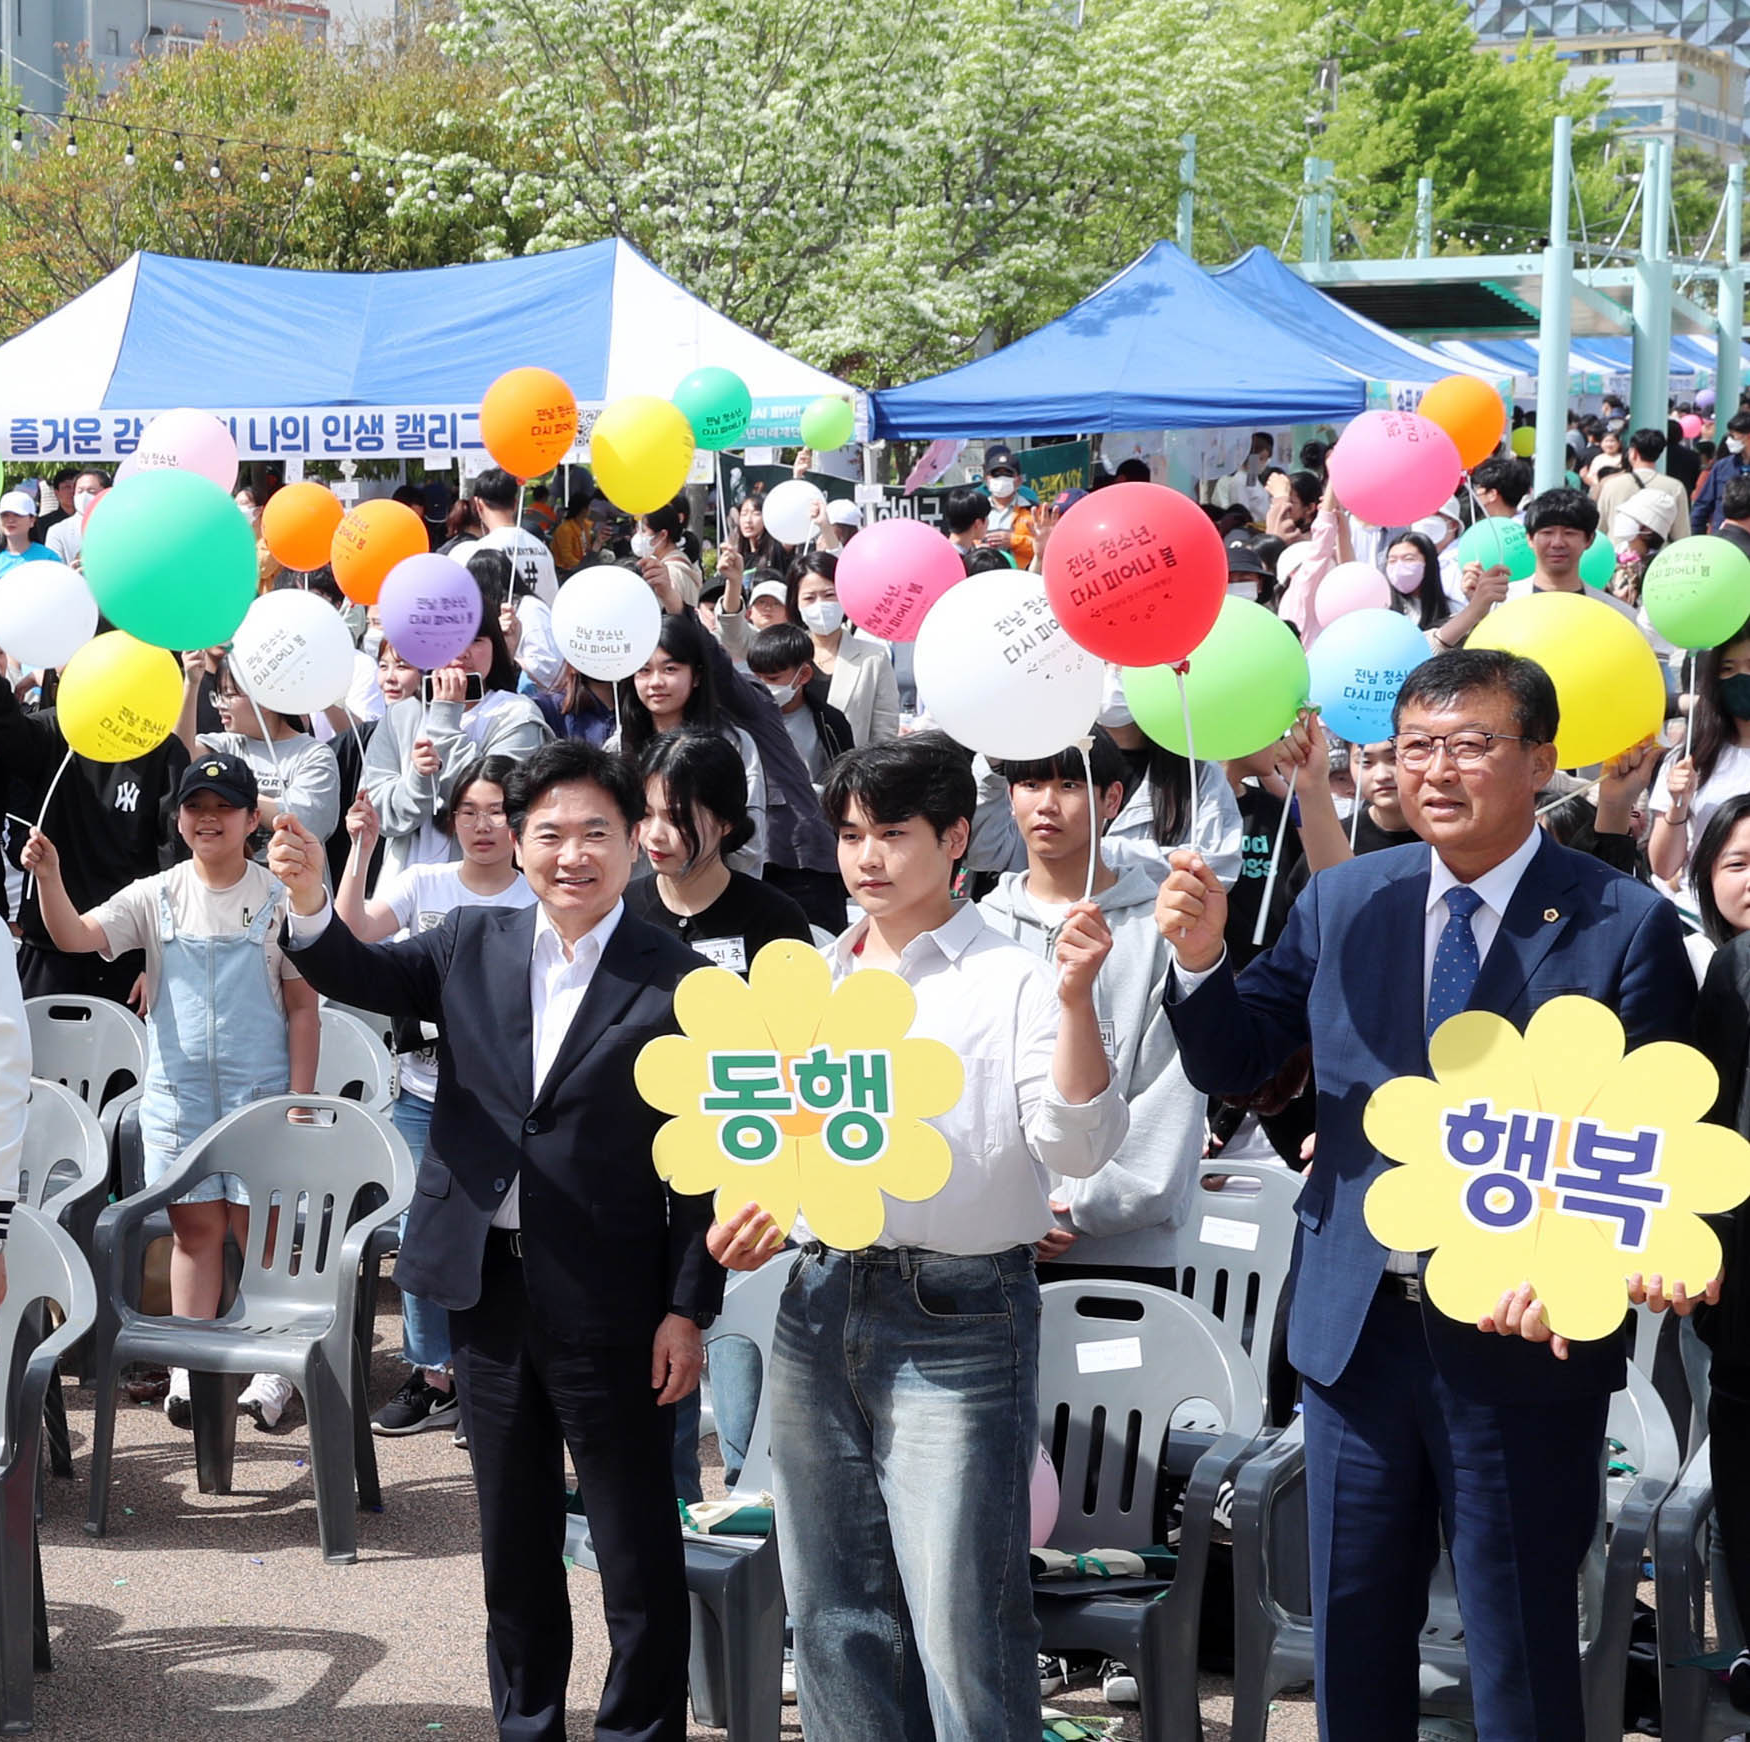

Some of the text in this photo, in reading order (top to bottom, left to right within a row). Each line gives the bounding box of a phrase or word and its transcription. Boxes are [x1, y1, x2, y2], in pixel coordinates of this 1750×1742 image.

[10, 417, 103, 455] 즐거운
[249, 416, 311, 452] 나의
[322, 414, 384, 451] 인생
[1066, 525, 1158, 579] 전남 청소년,
[1070, 581, 1102, 607] 다시
[1101, 553, 1157, 592] 피어나
[1159, 546, 1178, 569] 봄
[993, 609, 1027, 637] 전남
[1002, 634, 1038, 665] 다시
[1343, 686, 1370, 702] 다시
[1355, 668, 1379, 685] 전남
[704, 1049, 890, 1161] 동행
[1446, 1103, 1664, 1247] 행복
